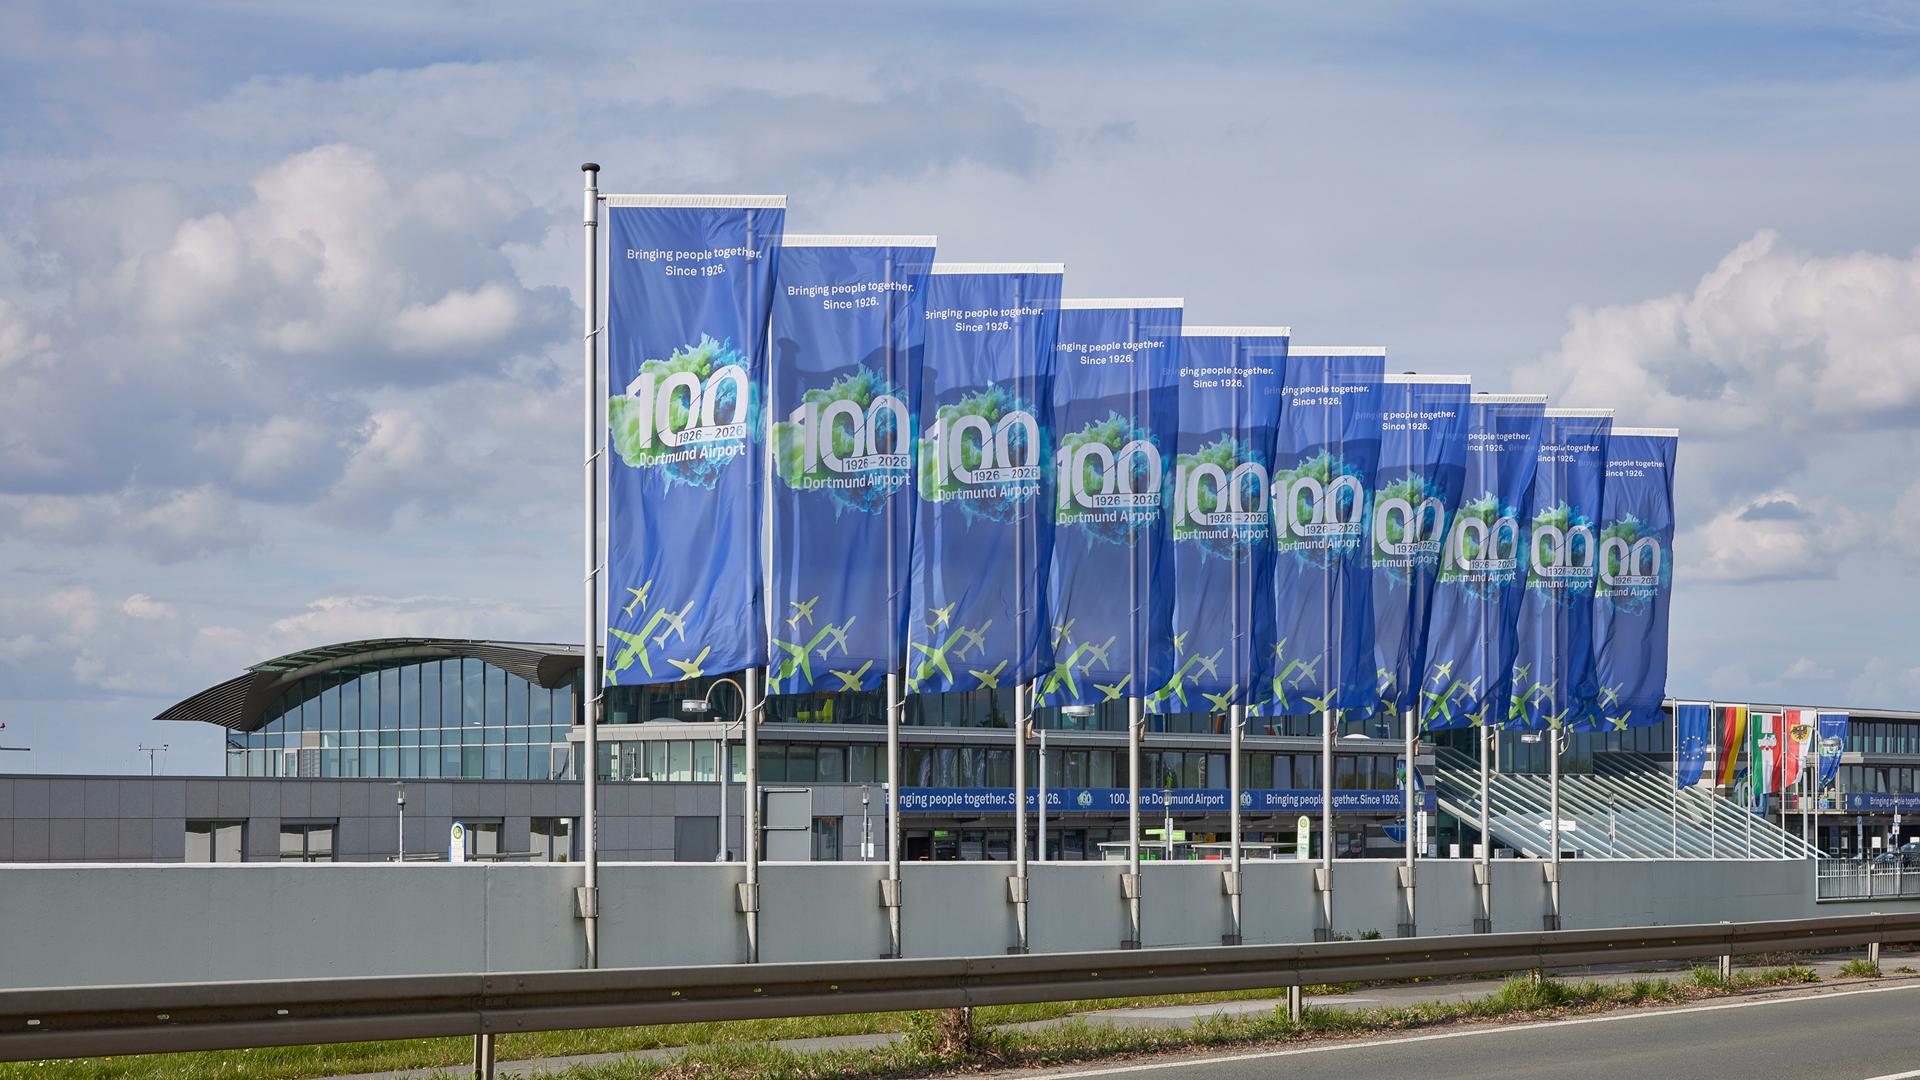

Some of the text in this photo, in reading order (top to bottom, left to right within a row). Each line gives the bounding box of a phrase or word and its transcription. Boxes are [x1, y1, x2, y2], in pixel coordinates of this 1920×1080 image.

[627, 246, 762, 262] Bringing people together.
[665, 264, 726, 277] Since 1926.
[788, 281, 914, 297] Bringing people together.
[823, 297, 879, 310] Since 1926.
[965, 308, 999, 319] people
[1000, 307, 1044, 318] together.
[955, 321, 1012, 332] Since 1926.
[1056, 340, 1165, 353] ringing people together.
[1080, 354, 1134, 365] Since 1926.
[1201, 366, 1233, 376] people
[1233, 366, 1274, 378] together.
[1193, 379, 1245, 389] Since 1926.
[1300, 384, 1330, 395] people
[1331, 384, 1369, 395] together.
[625, 364, 749, 449] 100
[1292, 396, 1341, 407] Since 1926.
[1391, 410, 1418, 420] people
[1420, 409, 1456, 421] together.
[1382, 421, 1430, 431] Since 1926.
[679, 429, 702, 444] 1926
[715, 424, 743, 439] 2026
[789, 394, 910, 474] 100
[1468, 432, 1495, 441] people
[1497, 433, 1530, 442] together.
[924, 410, 1040, 485] 100
[1485, 444, 1505, 452] 1926.
[1567, 444, 1600, 453] together.
[639, 442, 746, 467] Dortmund Airport
[845, 458, 869, 471] 1926
[878, 456, 908, 469] 2026
[1609, 460, 1634, 468] people
[974, 470, 1000, 481] 1926
[1012, 467, 1038, 479] 2026
[1057, 439, 1162, 509] 100
[1625, 469, 1645, 477] 1926.
[803, 472, 911, 490] Dortmund Airport
[938, 483, 1041, 501] Dortmund Airport
[1095, 496, 1121, 506] 1926
[1132, 494, 1159, 505] 2026
[1271, 475, 1363, 538] 100
[1059, 508, 1160, 525] Dortmund Airport
[1209, 514, 1232, 524] 1926
[1243, 513, 1267, 523] 2026
[1306, 526, 1328, 535] 1926
[1374, 496, 1445, 555] 00
[1175, 527, 1269, 541] Dortmund Airport
[1277, 538, 1325, 551] Dortmund
[1531, 525, 1594, 577] 00
[1372, 557, 1415, 568] ortmund
[1471, 561, 1489, 569] 1926
[1497, 560, 1515, 569] 2026
[1600, 537, 1660, 585] 00
[1443, 572, 1486, 582] Dortmund
[1572, 567, 1592, 576] 2026
[885, 792, 928, 808] nging
[929, 793, 962, 808] people
[964, 793, 1007, 808] together.
[1109, 793, 1125, 805] 100
[1152, 793, 1194, 805] Domund
[1195, 793, 1224, 807] Airport
[1266, 793, 1299, 808] Bringing
[1331, 793, 1360, 808] gether.
[1360, 794, 1380, 805] Since
[1381, 793, 1401, 805] 1926.
